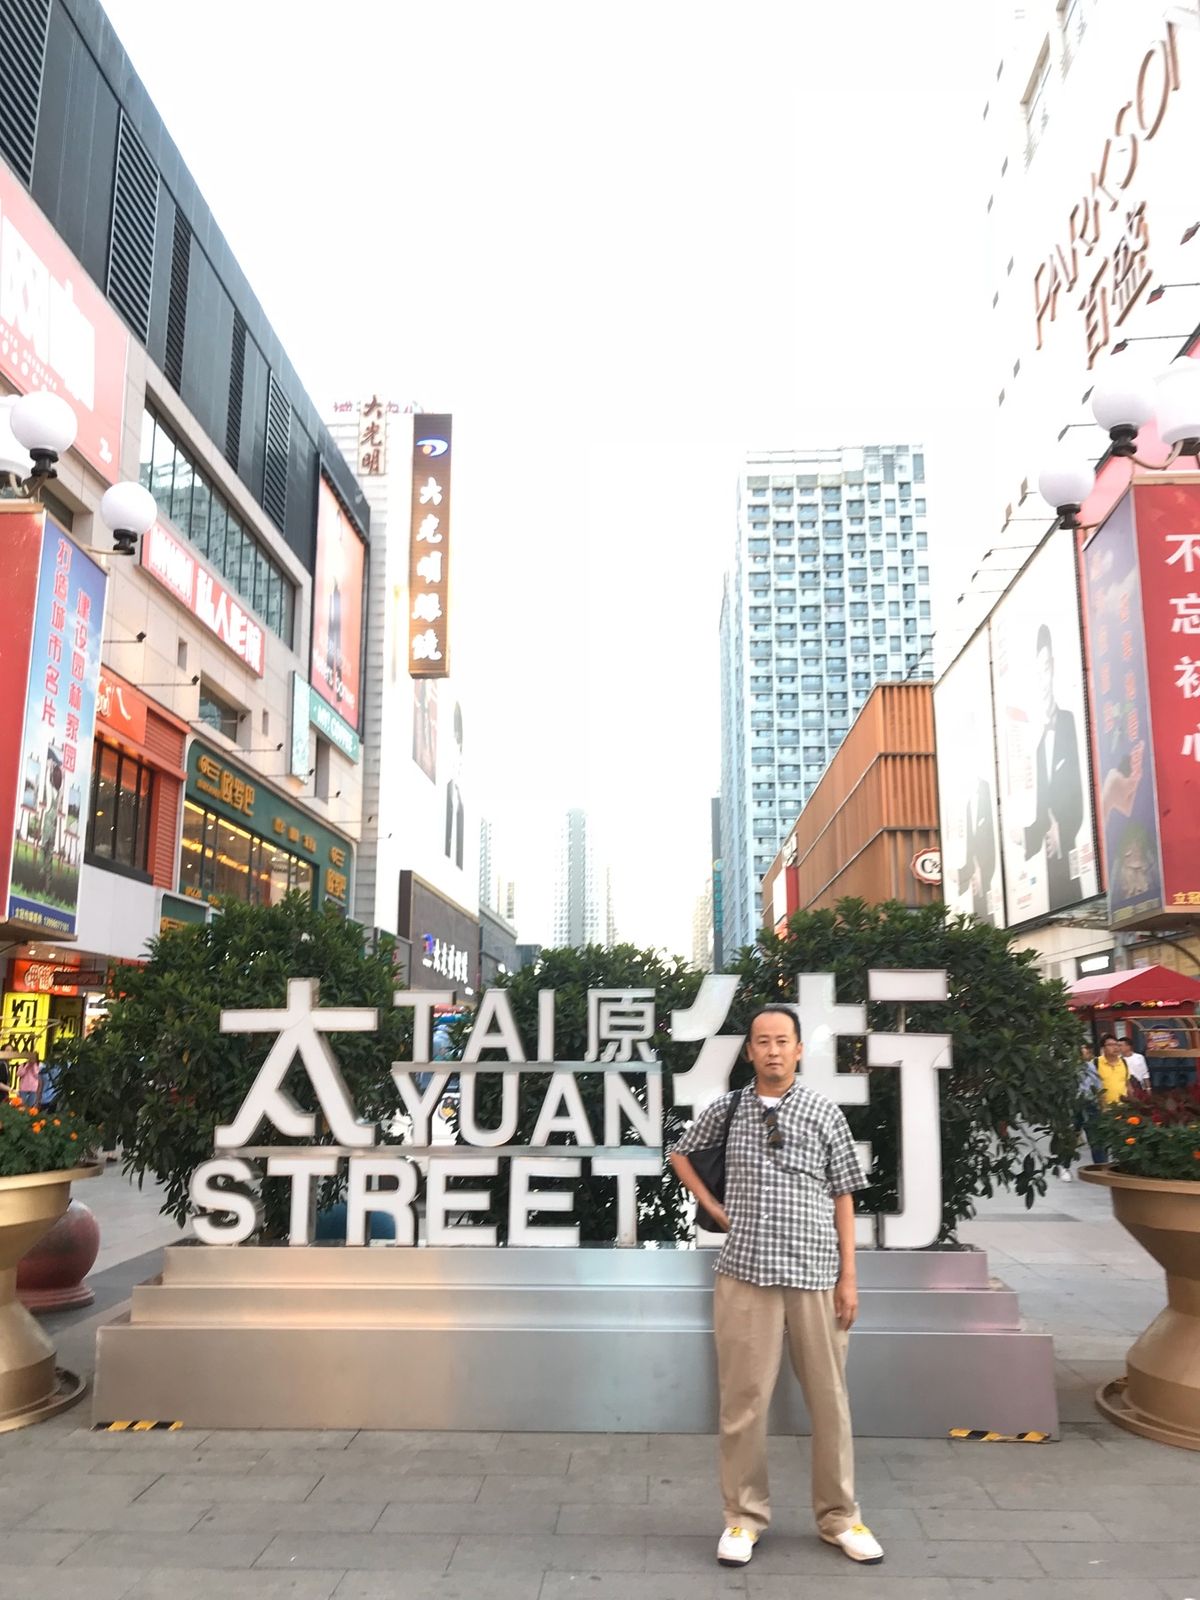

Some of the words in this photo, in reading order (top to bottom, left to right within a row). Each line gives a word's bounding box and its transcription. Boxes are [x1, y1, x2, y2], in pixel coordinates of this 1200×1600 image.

[359, 394, 384, 474] 大光明
[41, 537, 73, 728] 打造城市名片
[214, 977, 379, 1148] 太
[393, 988, 556, 1064] TAI
[584, 988, 657, 1064] 原
[392, 1070, 664, 1148] YUAN
[189, 1156, 665, 1247] STREET
